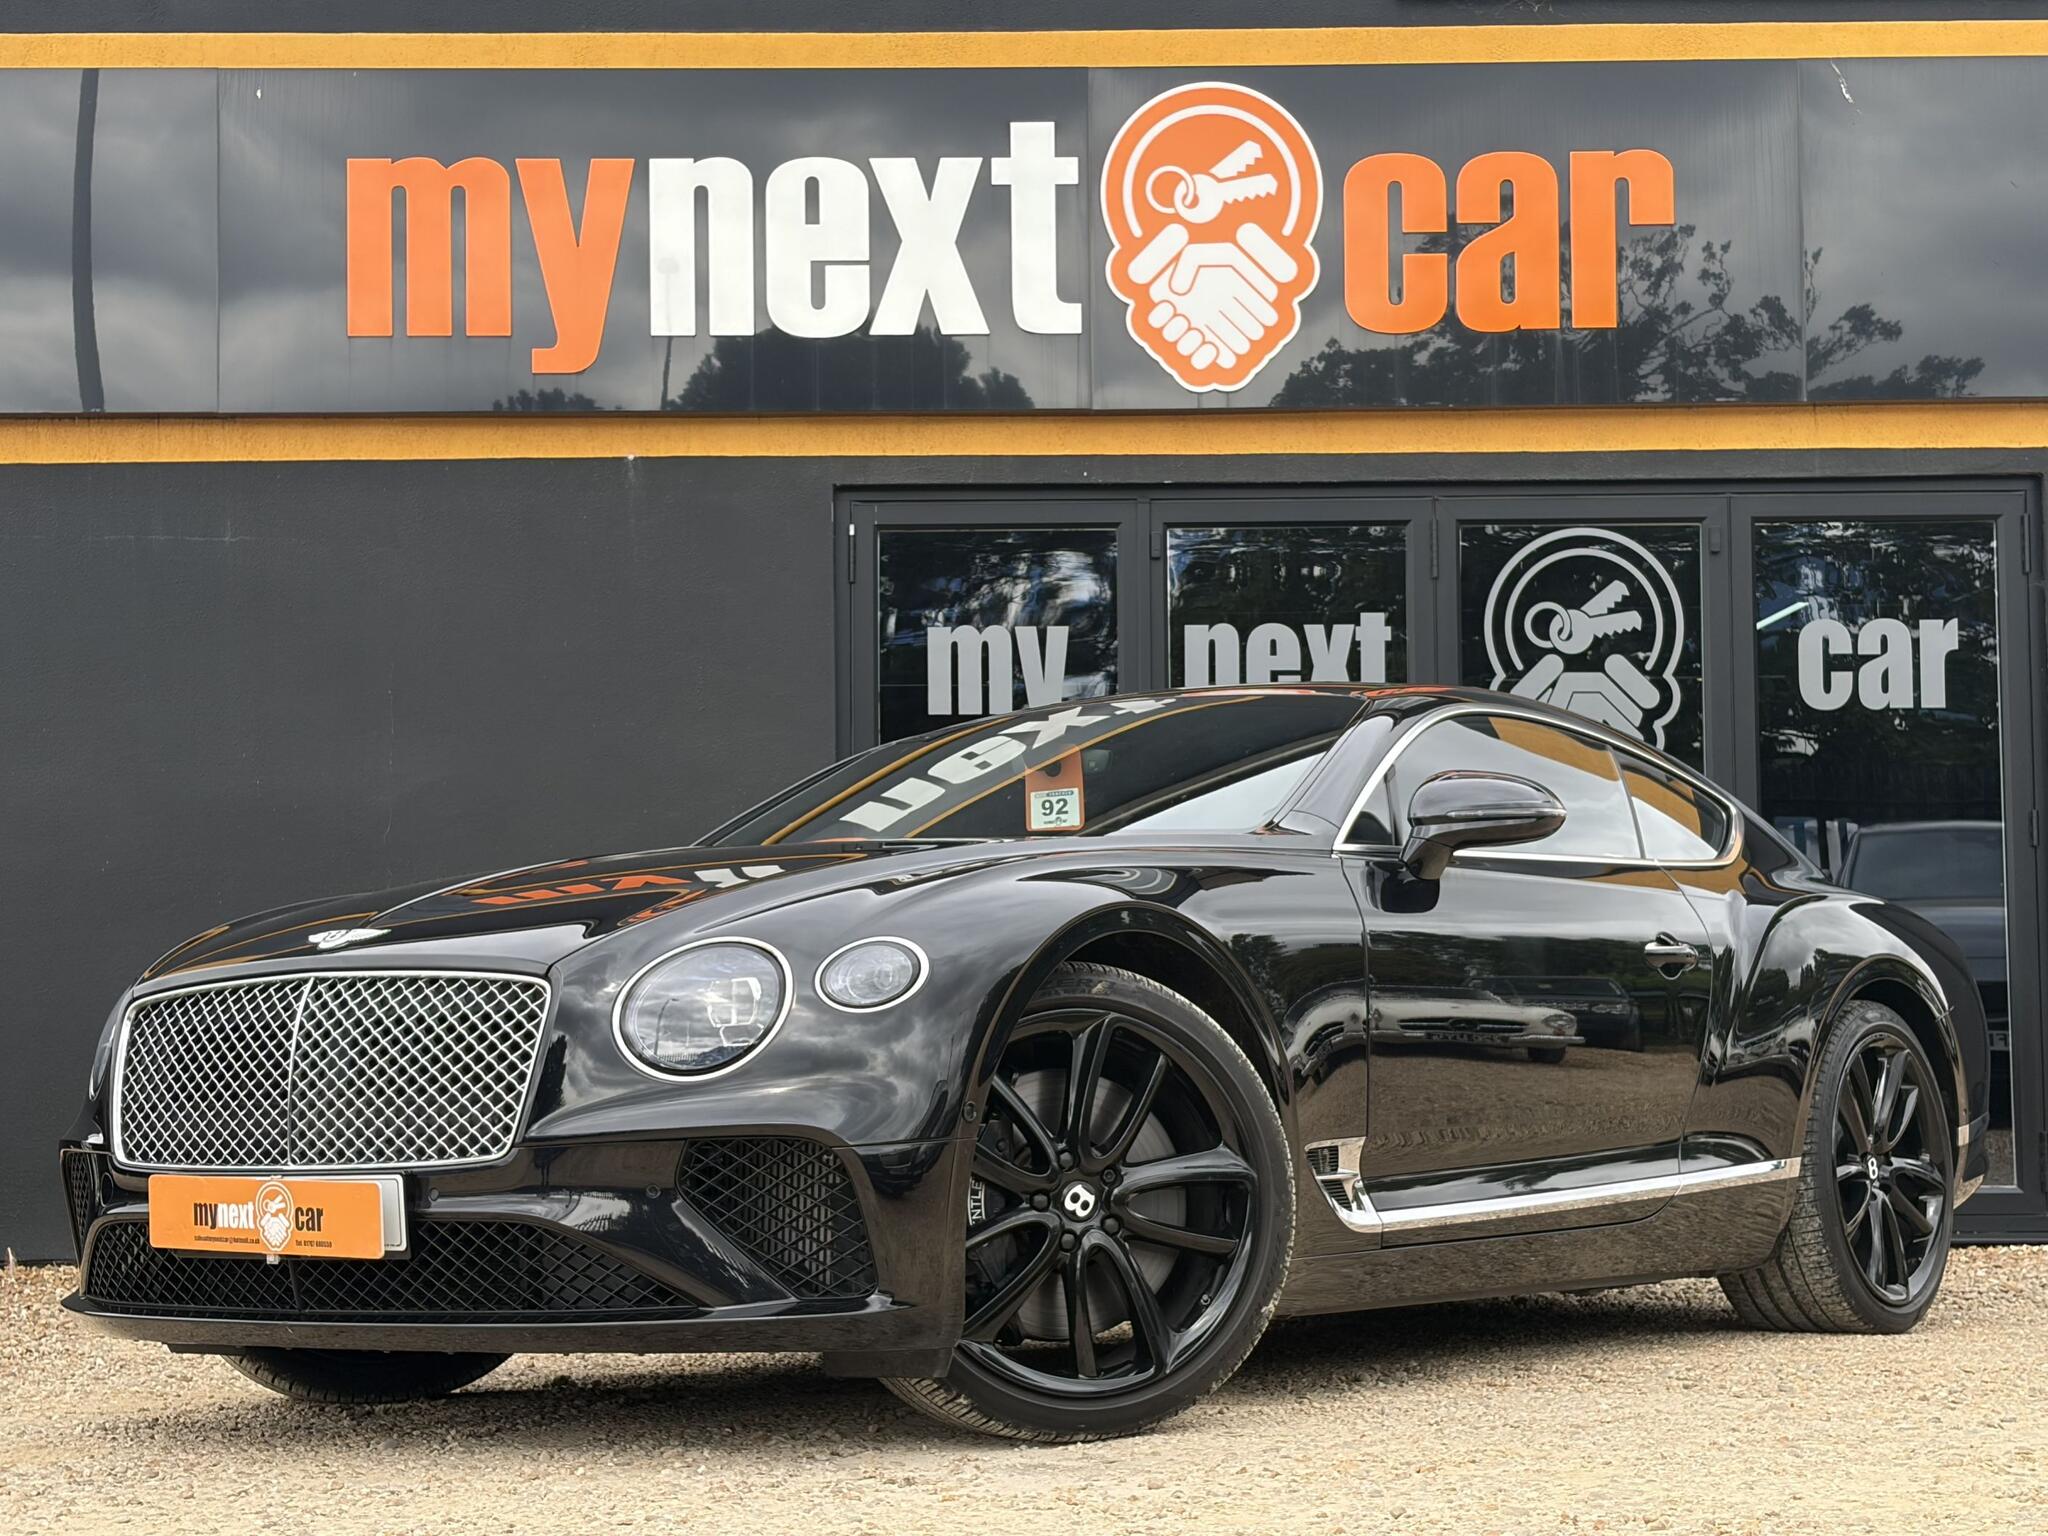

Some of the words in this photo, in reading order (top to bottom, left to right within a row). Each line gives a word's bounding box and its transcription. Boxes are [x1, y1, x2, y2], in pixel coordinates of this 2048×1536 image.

[1343, 149, 1675, 335] car
[926, 624, 1069, 715] my
[1184, 612, 1392, 684] next
[1798, 617, 1959, 711] car
[1041, 798, 1069, 816] 92
[1064, 1184, 1096, 1218] B
[294, 1206, 324, 1232] car
